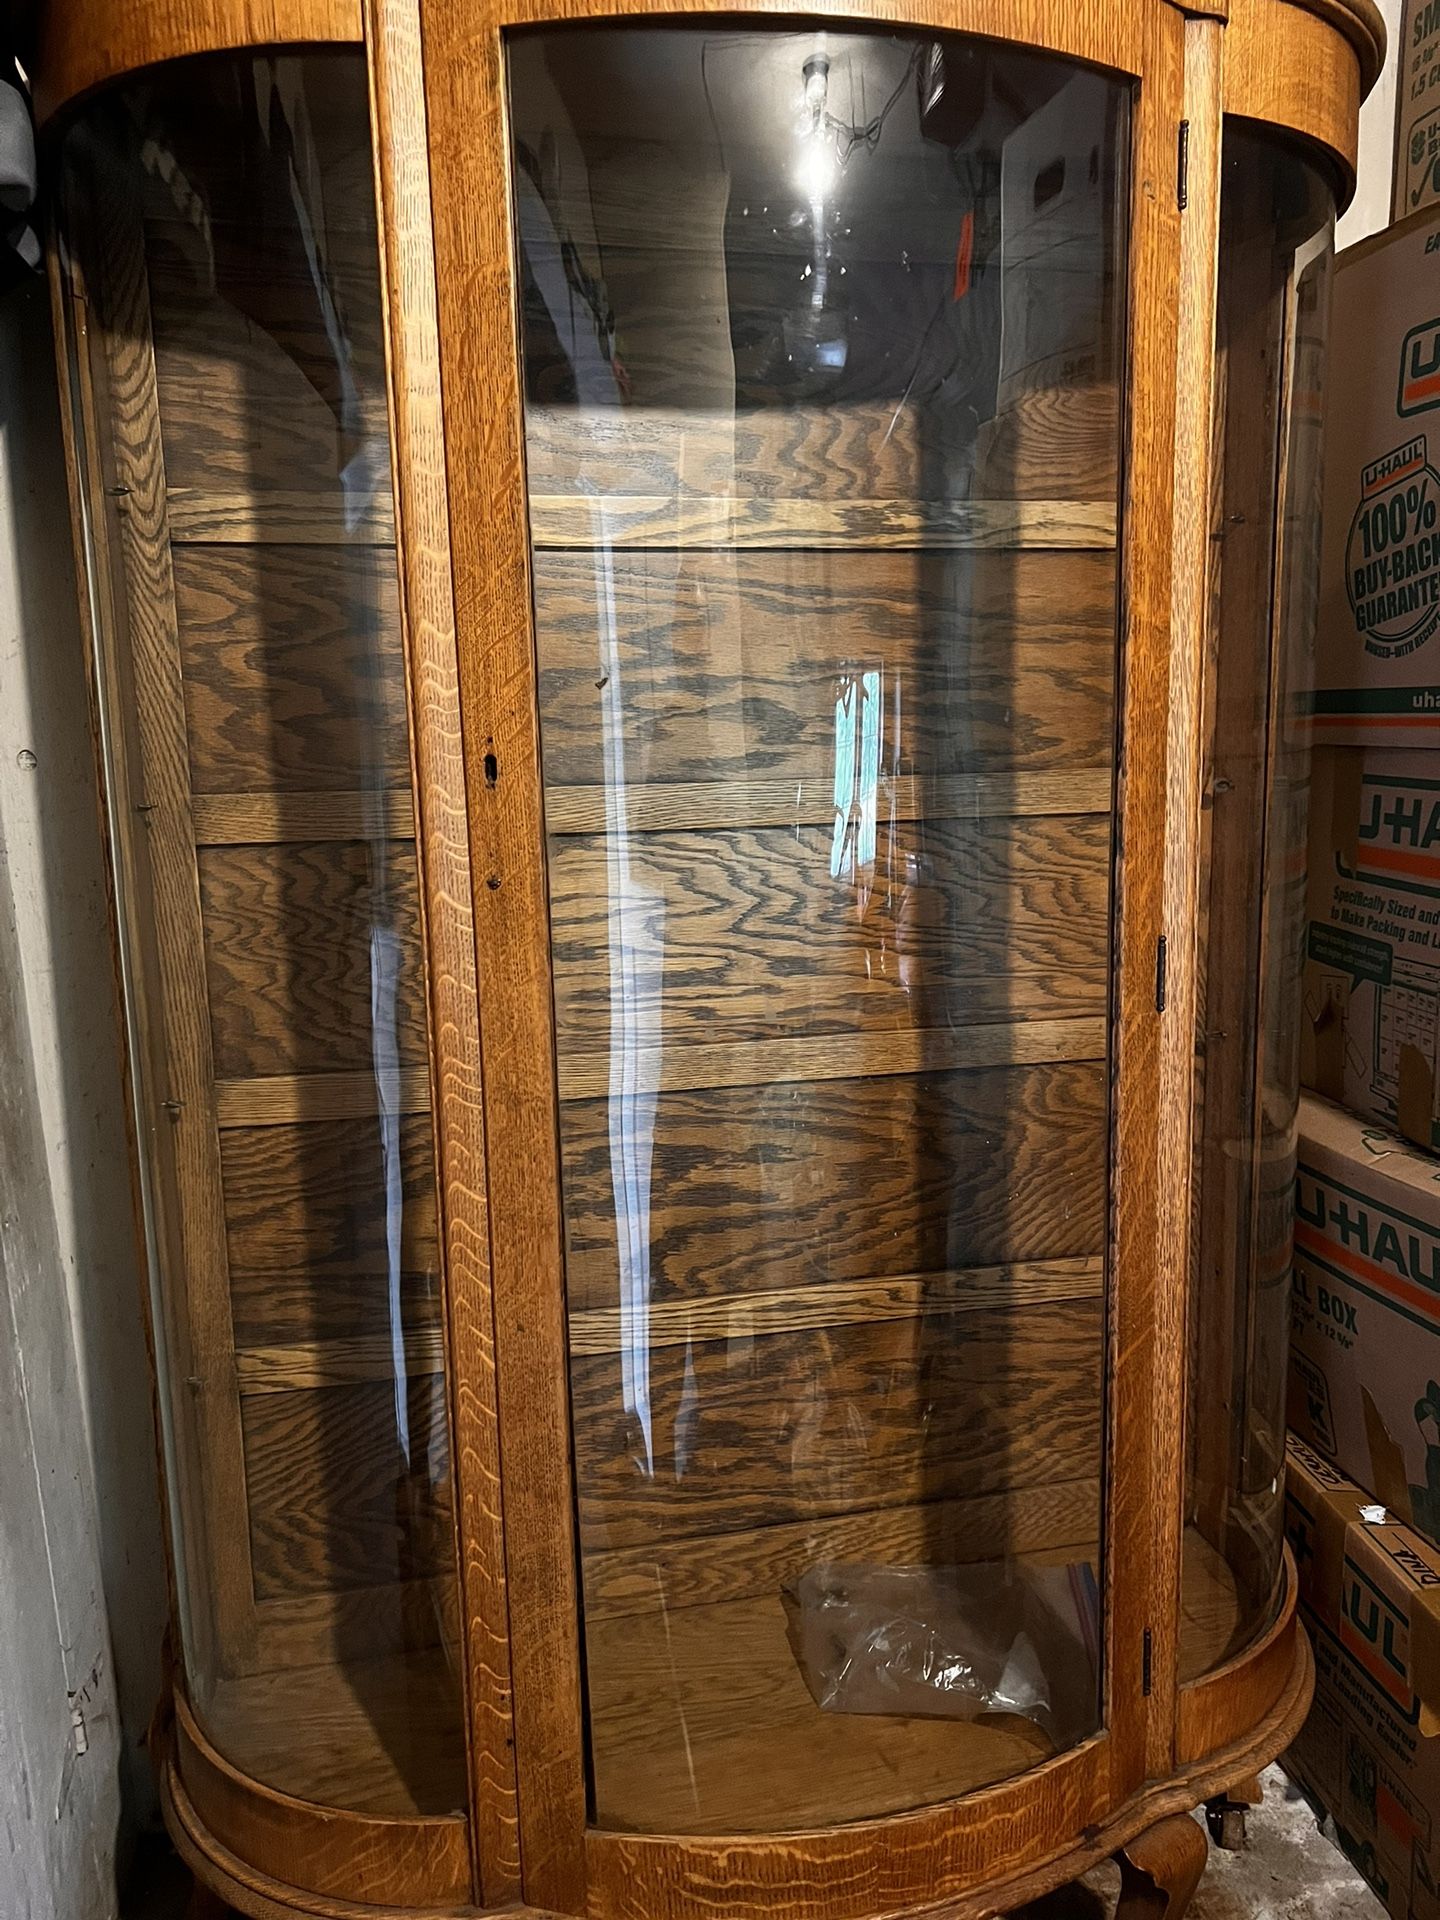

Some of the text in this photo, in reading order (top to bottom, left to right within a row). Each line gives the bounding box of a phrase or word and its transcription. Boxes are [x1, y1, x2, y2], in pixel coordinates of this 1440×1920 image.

[1364, 445, 1423, 487] U-HAUL
[1358, 478, 1436, 558] 100%
[1330, 905, 1340, 920] to
[1341, 908, 1365, 928] Make
[1366, 916, 1406, 942] Packing
[1408, 930, 1430, 945] and
[1333, 885, 1440, 925] Specifically Sized and
[1317, 1285, 1359, 1335] BOX
[1333, 1672, 1374, 1727] Loading
[1341, 1661, 1416, 1751] Manufactured
